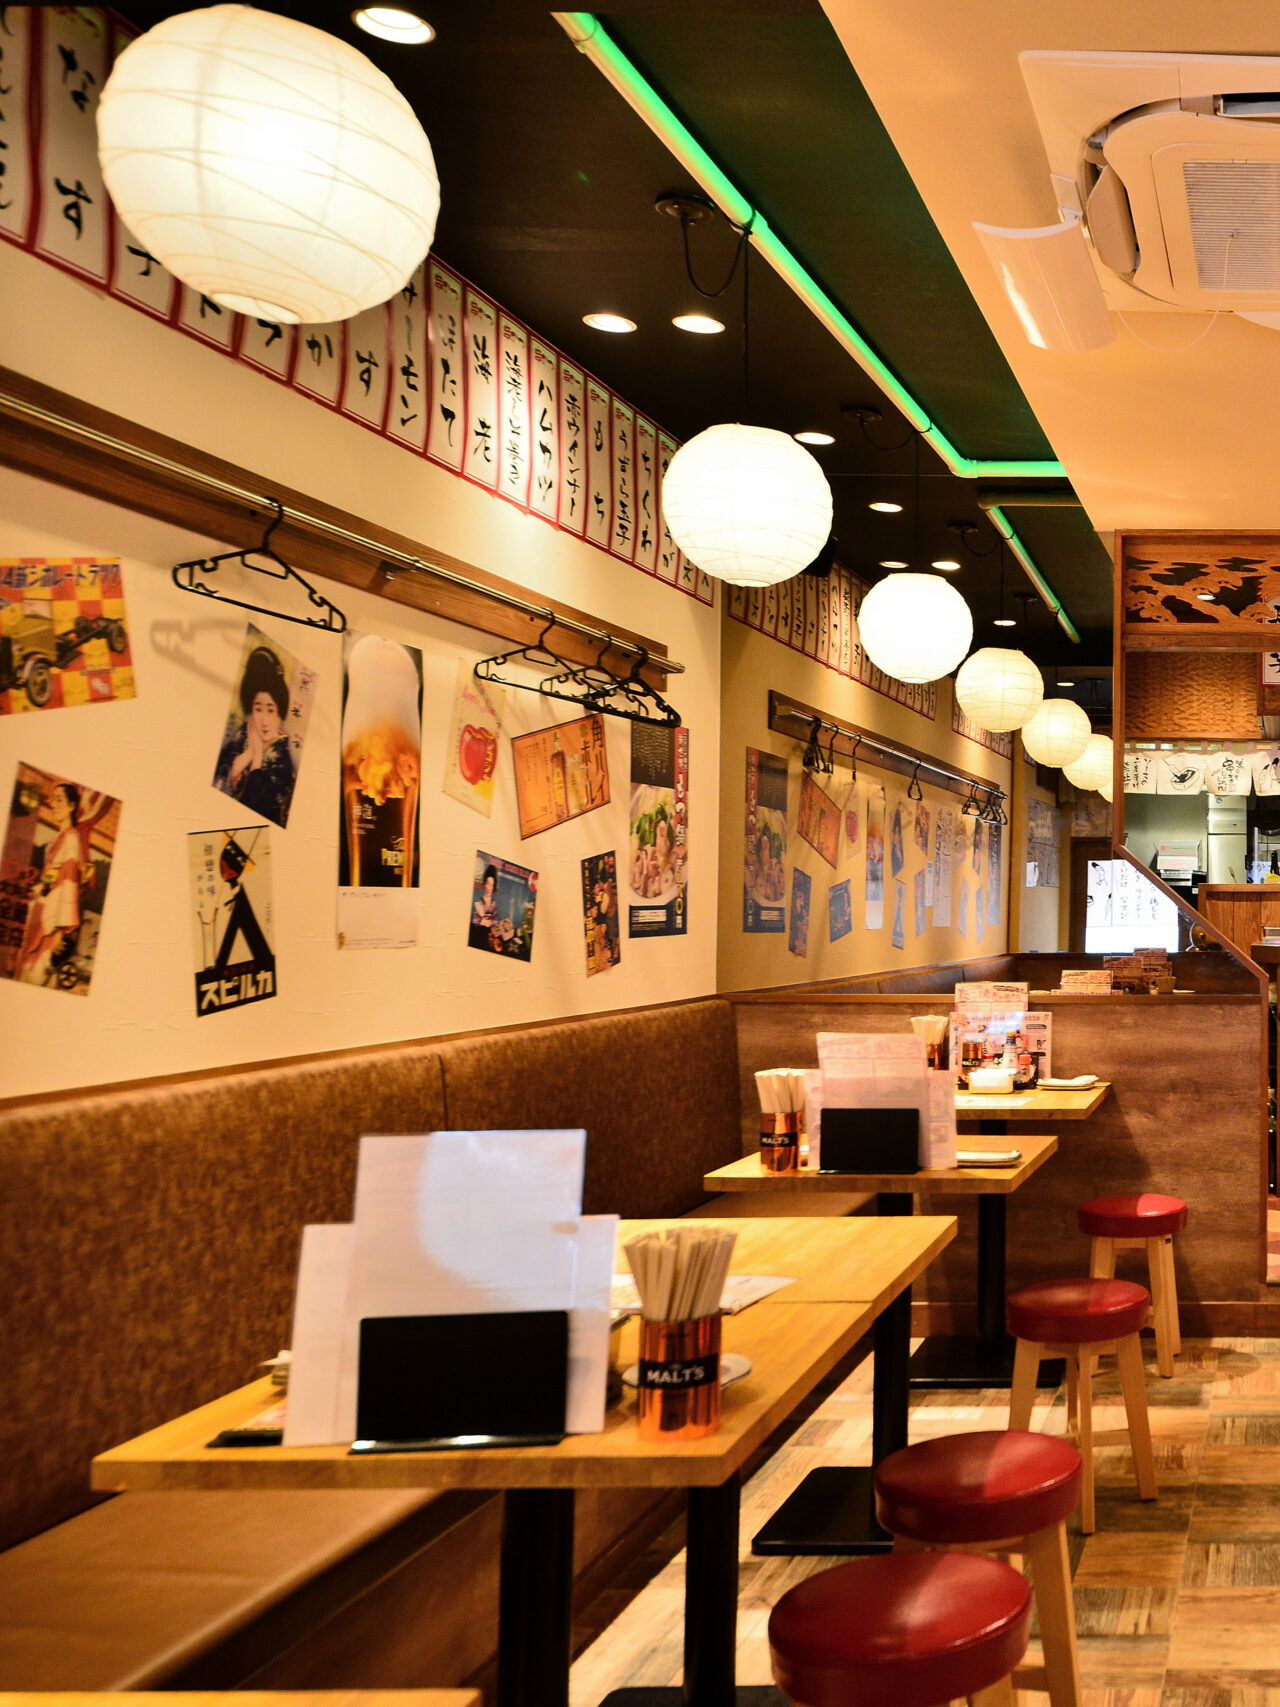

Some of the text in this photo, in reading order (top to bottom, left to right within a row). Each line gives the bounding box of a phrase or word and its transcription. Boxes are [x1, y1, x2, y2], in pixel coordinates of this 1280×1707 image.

[537, 379, 554, 502] ハムカツ
[645, 1363, 706, 1385] MALT'S
